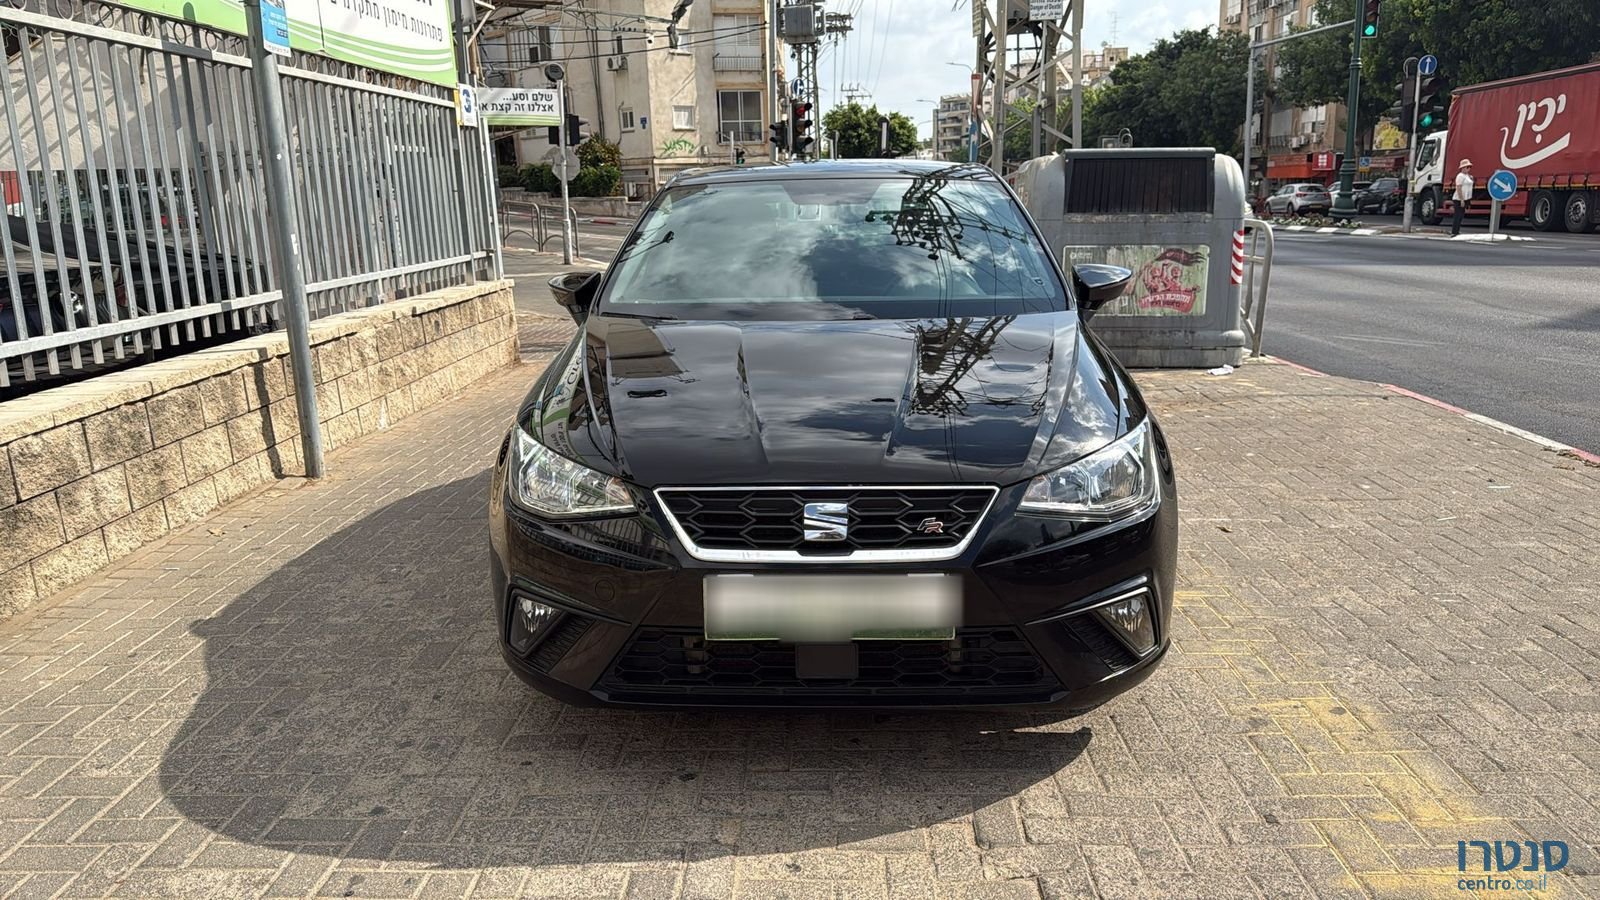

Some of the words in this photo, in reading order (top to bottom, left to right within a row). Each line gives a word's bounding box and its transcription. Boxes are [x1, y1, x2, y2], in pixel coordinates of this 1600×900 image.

[383, 6, 408, 29] מימון
[411, 17, 443, 42] פתרונות
[503, 92, 529, 101] וסע...
[532, 91, 553, 102] שלם
[491, 102, 512, 114] קצת
[514, 103, 525, 112] זה
[527, 102, 554, 112] אצלנו
[916, 517, 944, 533] FR
